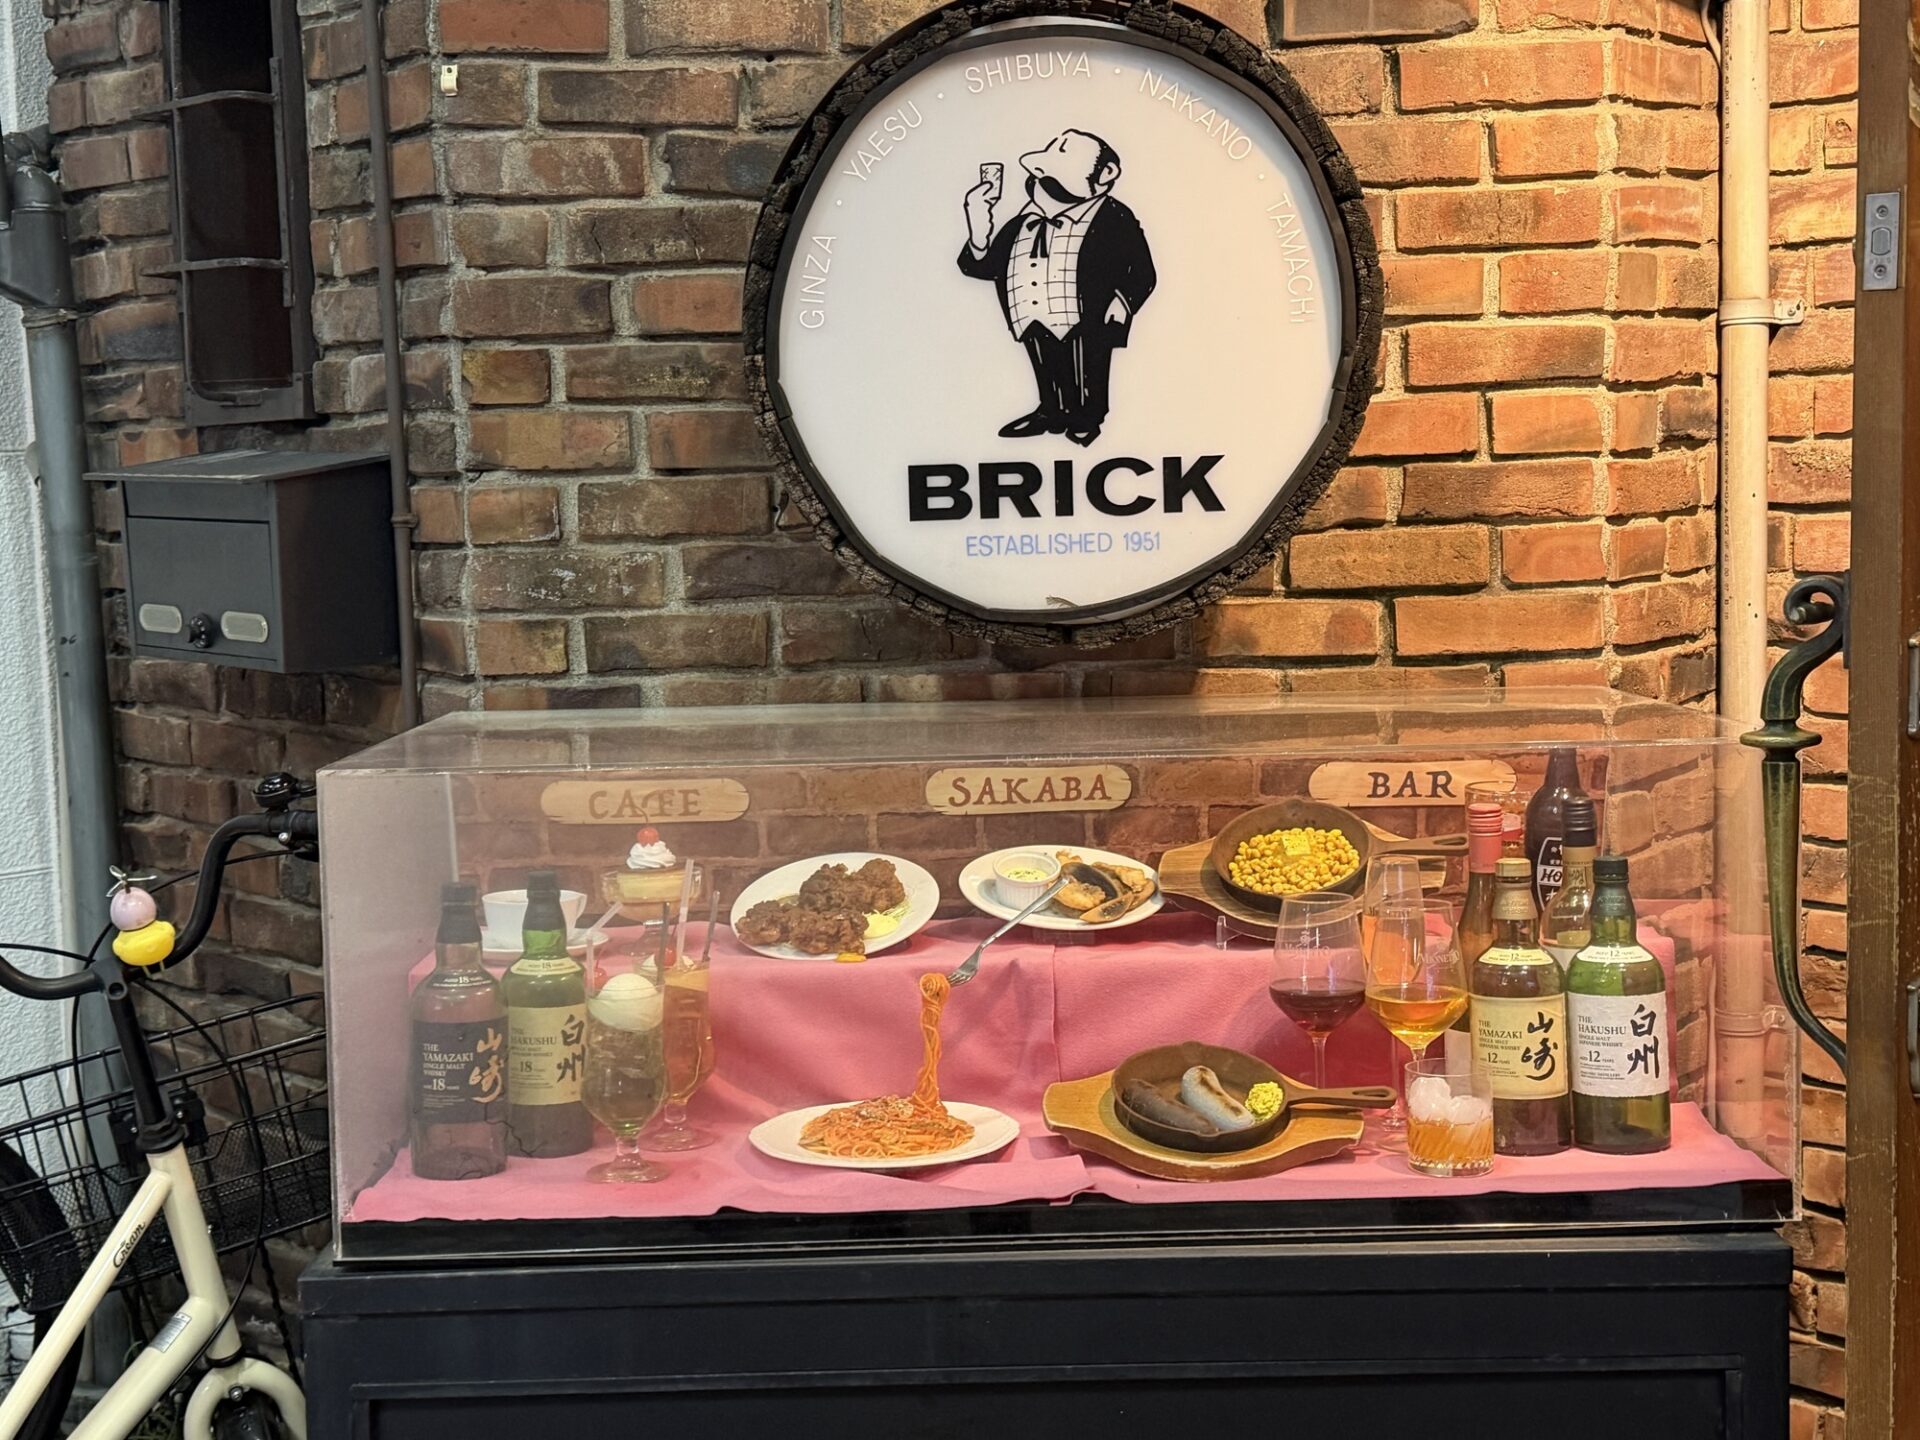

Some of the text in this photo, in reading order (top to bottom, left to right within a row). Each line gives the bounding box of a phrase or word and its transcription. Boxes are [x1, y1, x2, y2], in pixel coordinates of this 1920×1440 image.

[965, 49, 1092, 95] SHIBUYA
[1140, 68, 1253, 163] NAKANO
[843, 100, 925, 185] YAESU
[1264, 192, 1316, 324] TAMACHI
[798, 231, 838, 331] GINZA
[907, 454, 1227, 523] BRICK
[966, 531, 1162, 557] ESTABLISHED 1951
[948, 773, 1112, 808] SAKABA
[1366, 770, 1457, 799] BAR
[588, 788, 702, 820] CAFE
[459, 975, 470, 984] 18
[1478, 1019, 1491, 1028] THE
[1578, 1015, 1593, 1024] THE
[1578, 1023, 1627, 1035] HAKUSHU
[1478, 1027, 1523, 1040] YAMAZAKI
[1627, 1003, 1660, 1079] 白州
[423, 1043, 440, 1052] THE
[423, 1052, 474, 1063] YAMAZAKI
[556, 1014, 586, 1083] 白州
[1487, 1052, 1498, 1064] 12
[1588, 1049, 1601, 1063] 12
[520, 1061, 533, 1073] 18
[432, 1078, 446, 1091] 18
